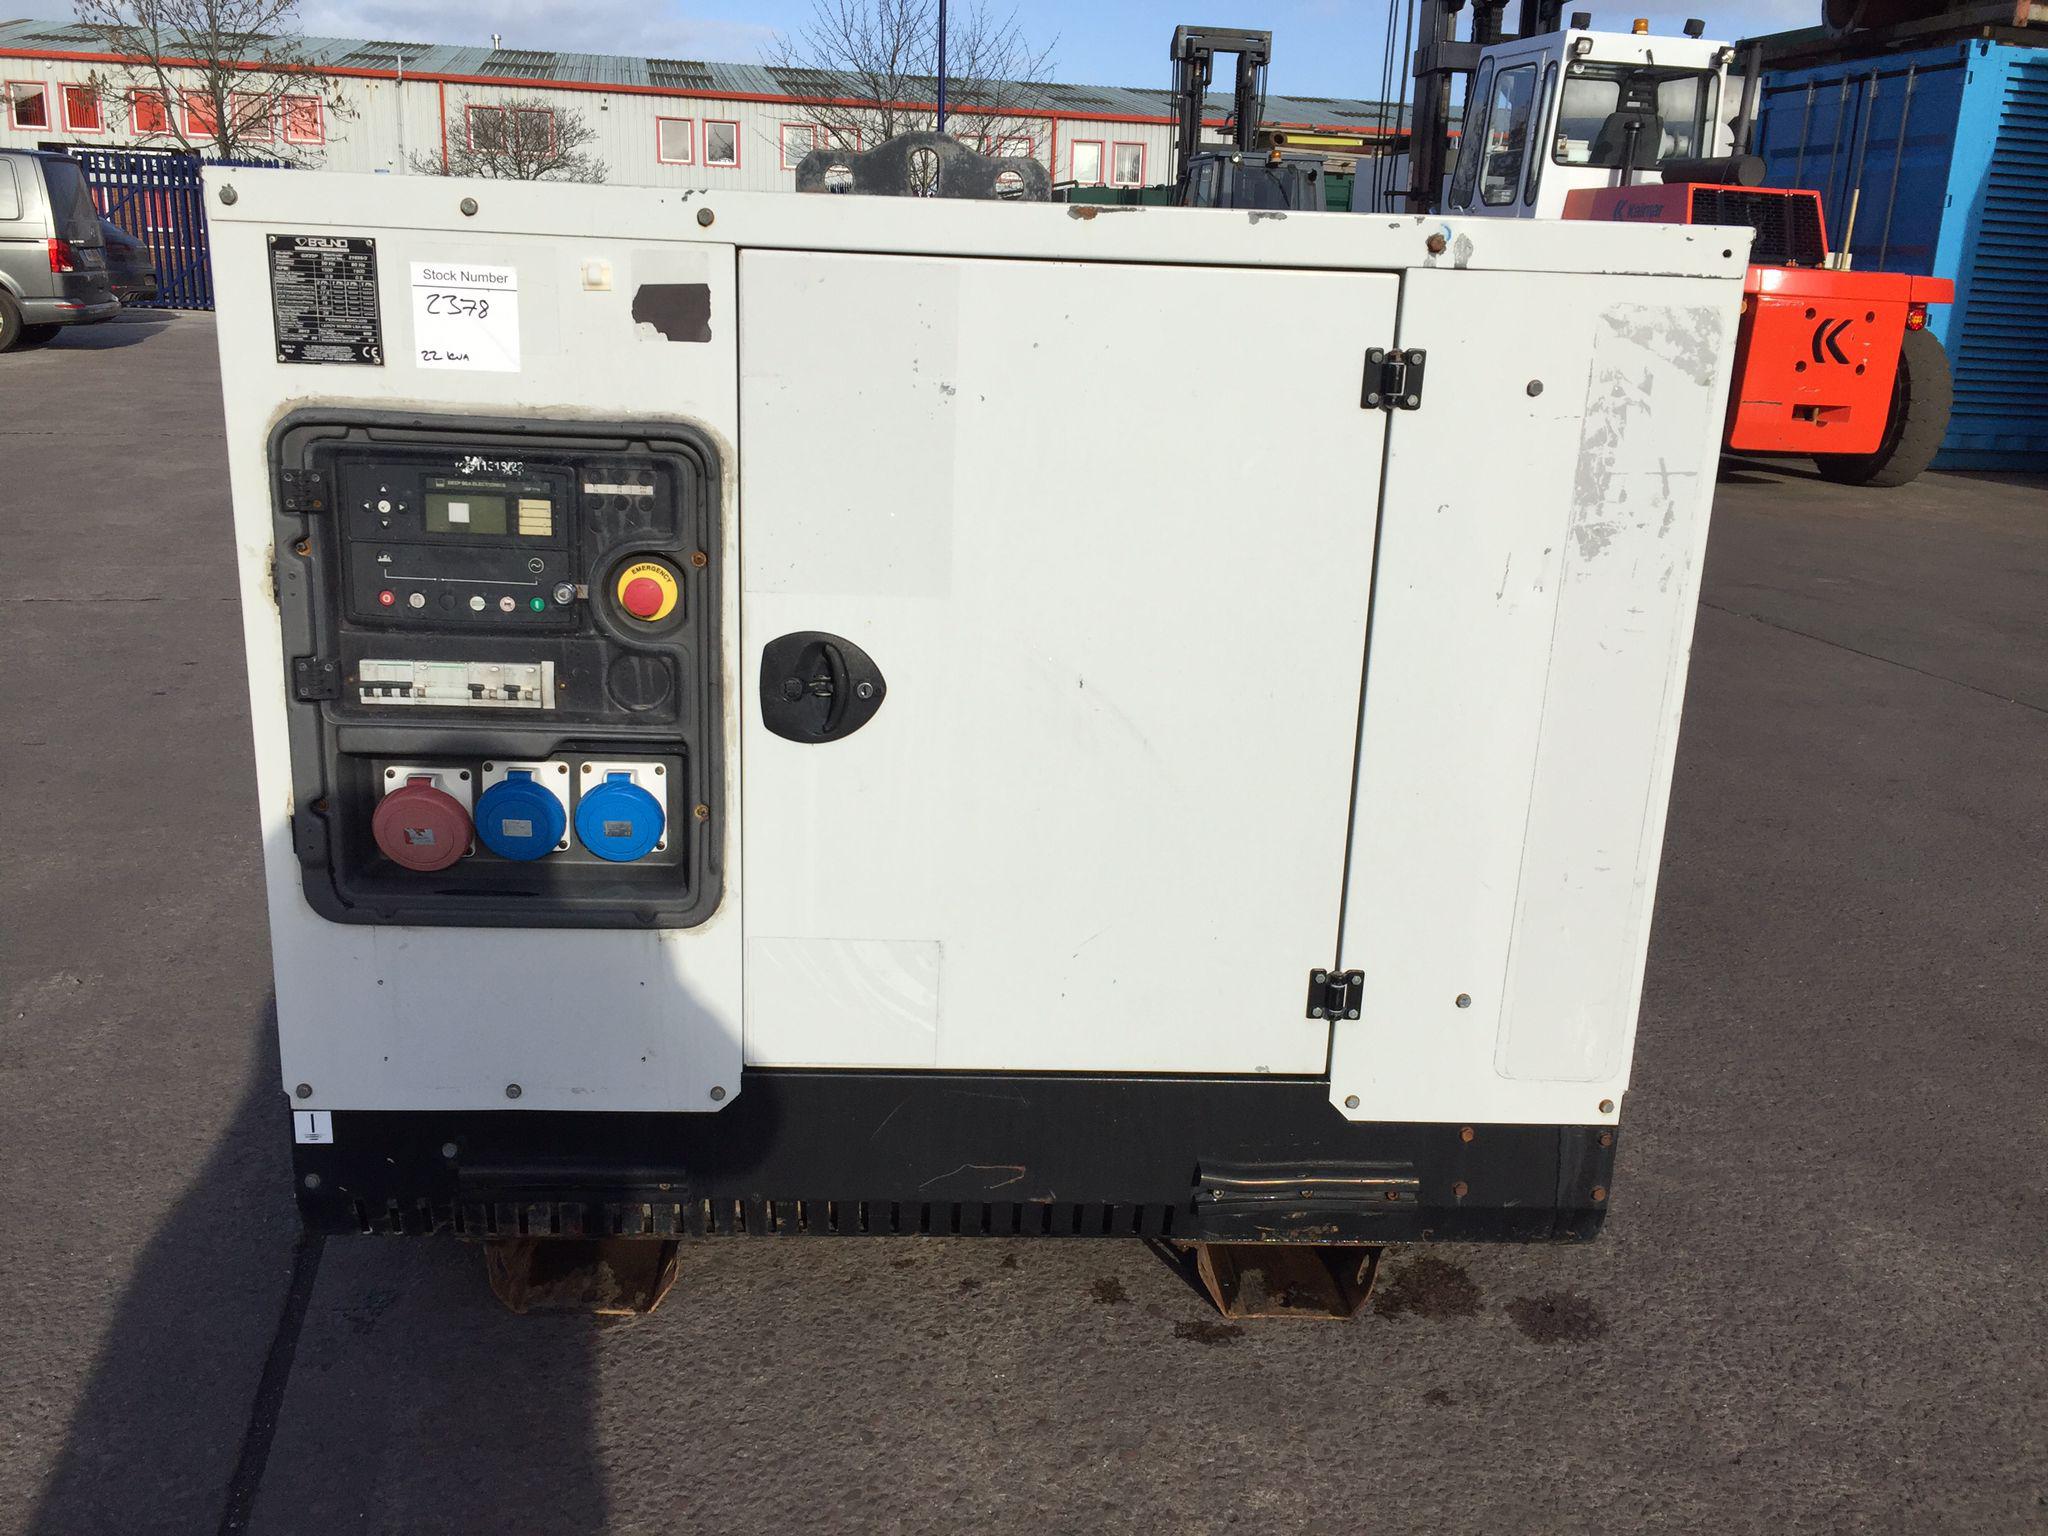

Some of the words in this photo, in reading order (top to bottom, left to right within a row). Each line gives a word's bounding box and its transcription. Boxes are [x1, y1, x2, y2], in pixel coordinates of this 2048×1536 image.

[308, 238, 348, 248] BRUNO
[423, 268, 457, 281] Stock
[460, 271, 509, 283] Number
[427, 293, 489, 319] 2378
[421, 350, 443, 361] 22
[631, 565, 672, 583] EMERGENCY
